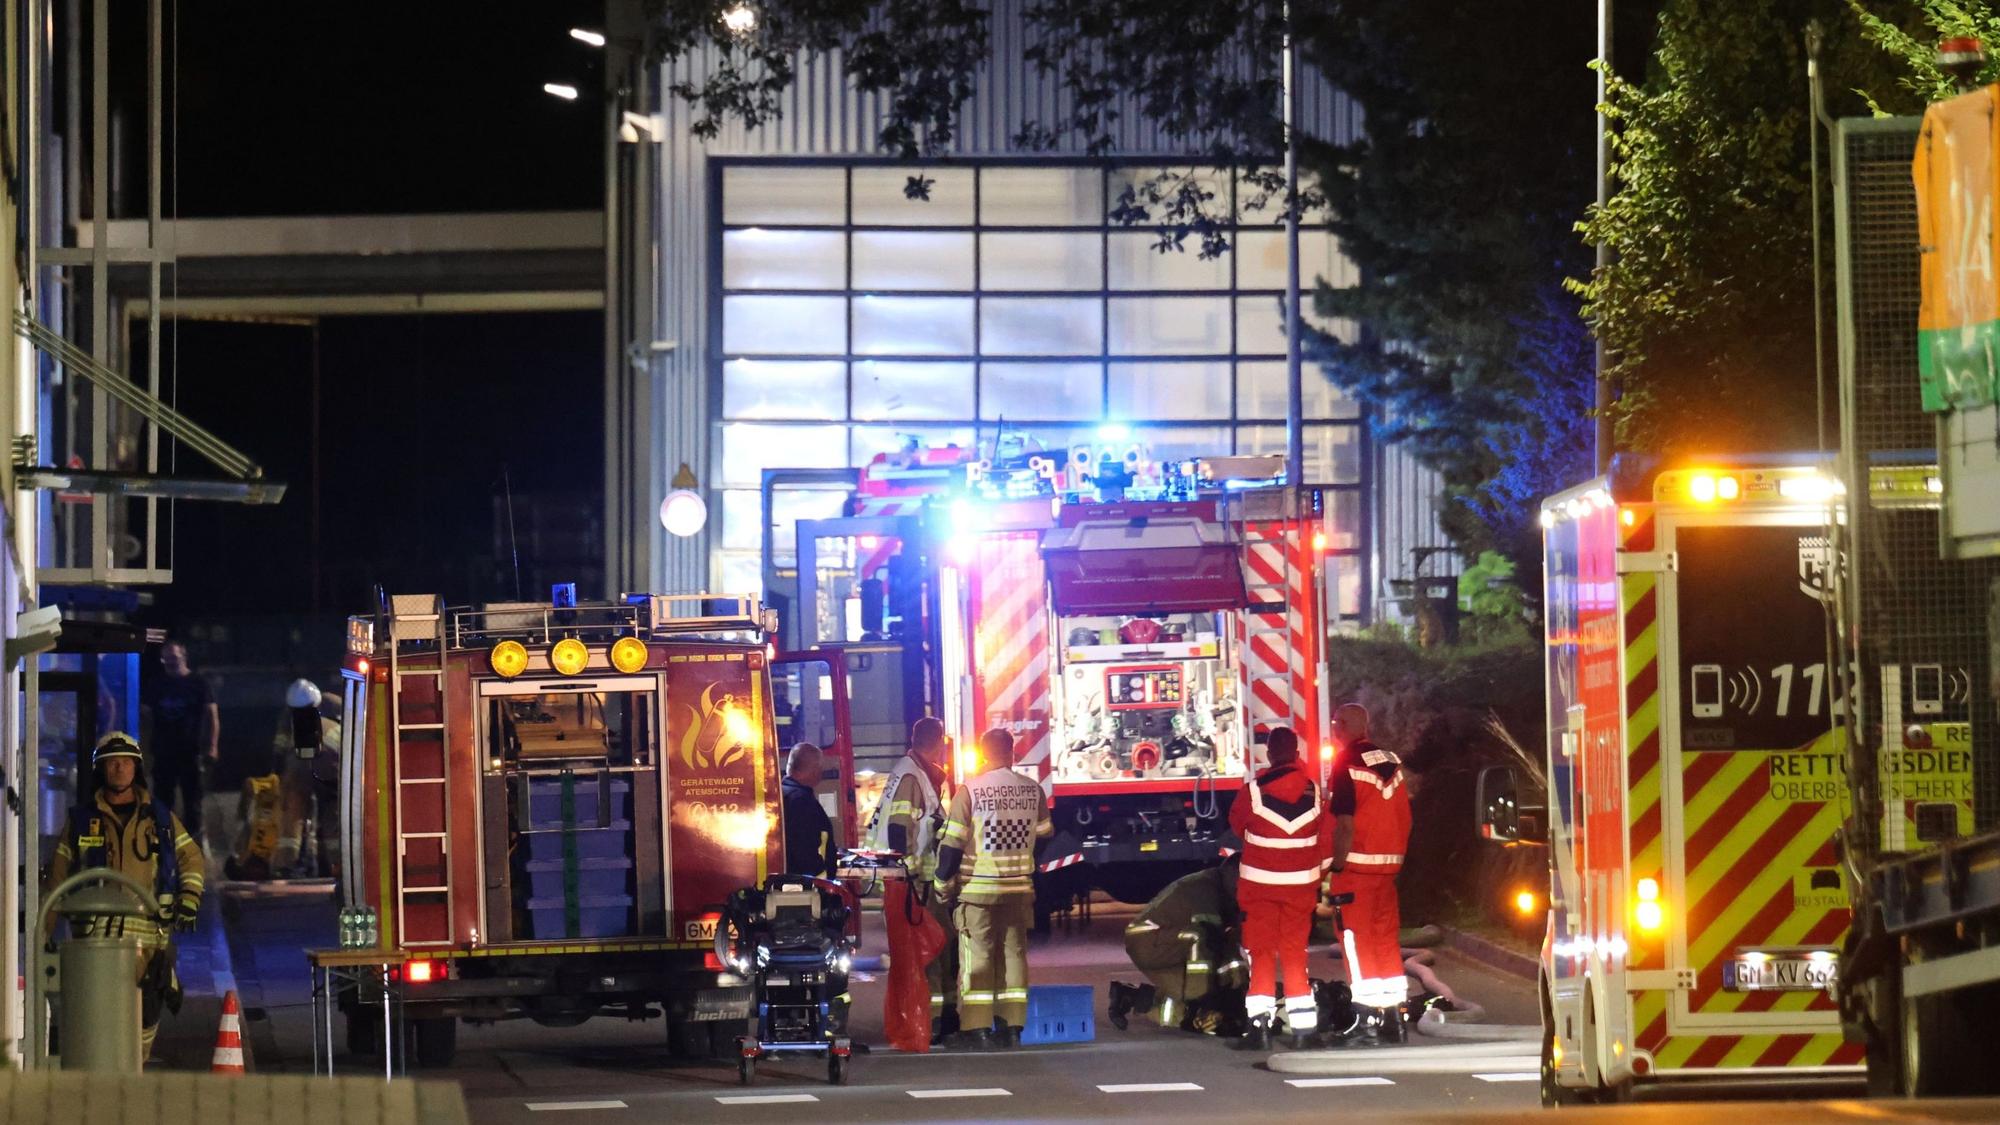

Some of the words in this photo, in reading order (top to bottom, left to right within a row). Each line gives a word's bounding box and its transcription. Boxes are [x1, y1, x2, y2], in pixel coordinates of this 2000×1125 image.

[685, 787, 740, 796] ATEMSCHUTZ
[973, 785, 1037, 799] FACHGRUPPE
[975, 798, 1037, 812] ATEMSCHUTZ
[1775, 963, 1799, 983] KV
